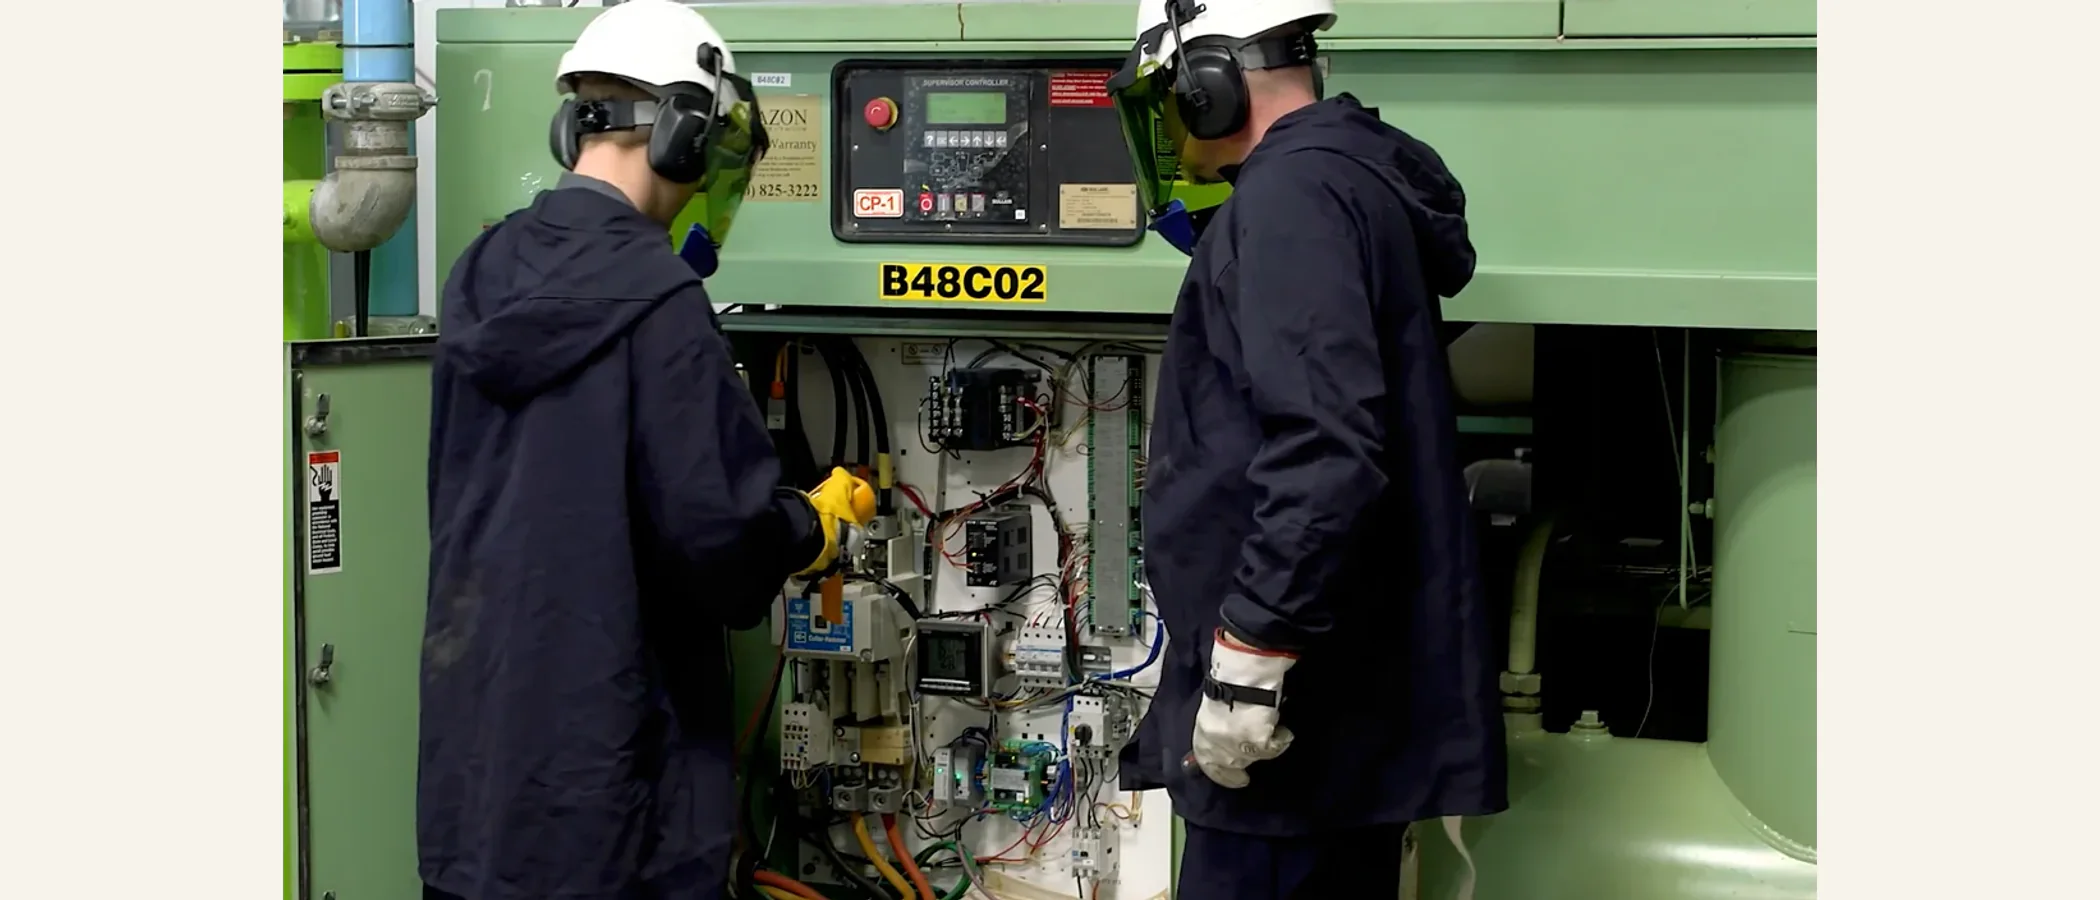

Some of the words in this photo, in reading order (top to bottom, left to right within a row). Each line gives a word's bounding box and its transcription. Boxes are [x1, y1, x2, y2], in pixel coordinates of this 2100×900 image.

[757, 75, 785, 84] B48C02
[760, 184, 818, 196] 825-3222
[860, 196, 894, 211] CP-1
[883, 265, 1044, 300] B48C02
